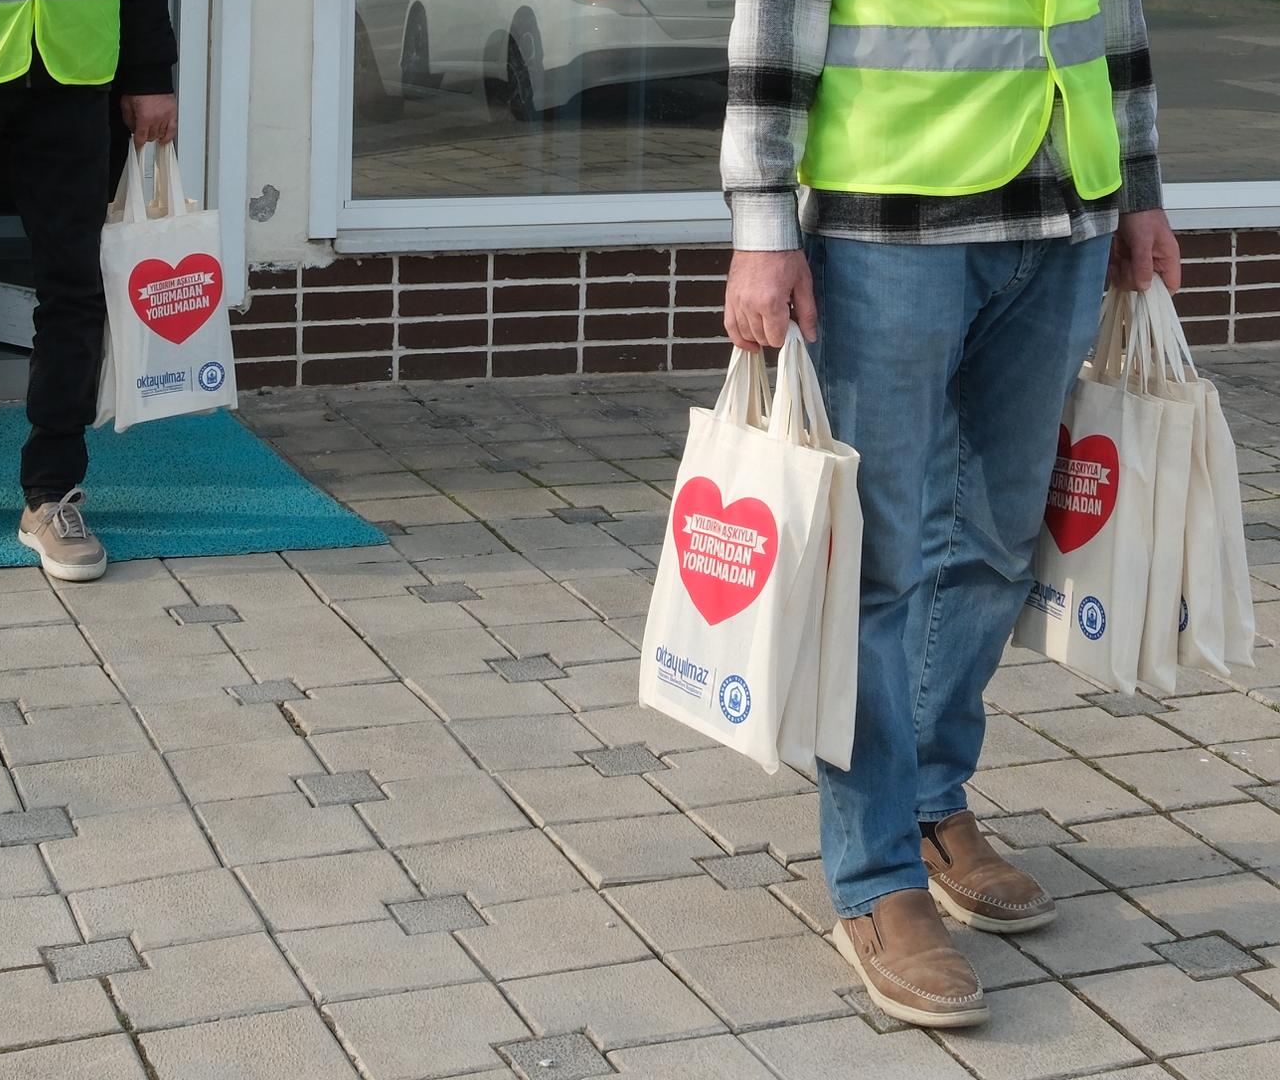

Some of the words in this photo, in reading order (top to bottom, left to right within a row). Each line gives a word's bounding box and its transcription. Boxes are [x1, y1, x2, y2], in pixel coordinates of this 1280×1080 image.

[146, 295, 210, 321] YORULMADAN
[150, 284, 203, 307] DURMADAN
[689, 532, 753, 566] DURMADAN
[682, 550, 756, 588] YORULMADAN
